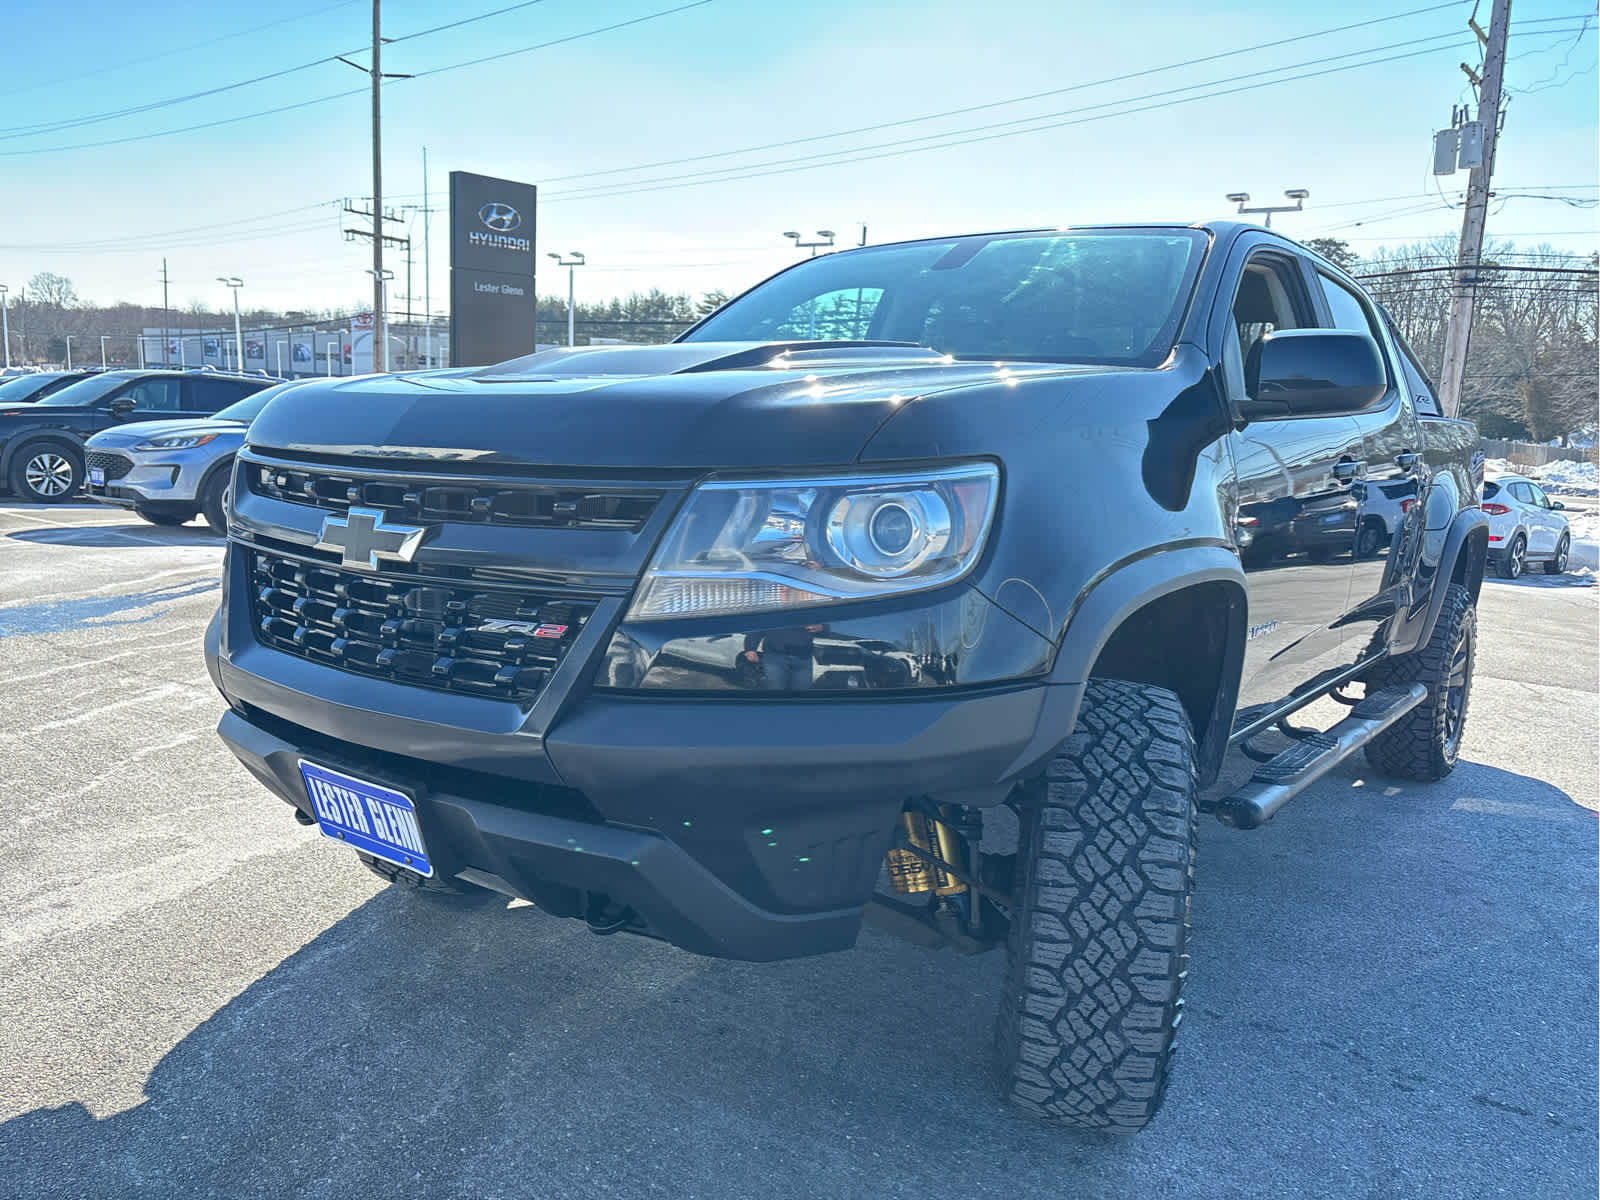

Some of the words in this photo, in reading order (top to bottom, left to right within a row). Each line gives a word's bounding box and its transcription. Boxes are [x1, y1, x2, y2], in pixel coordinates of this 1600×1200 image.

[469, 231, 530, 251] HYUNDAI
[474, 281, 500, 295] Lester
[478, 618, 569, 639] ZR2
[308, 777, 371, 835] LESTER
[365, 797, 425, 855] GLENN
